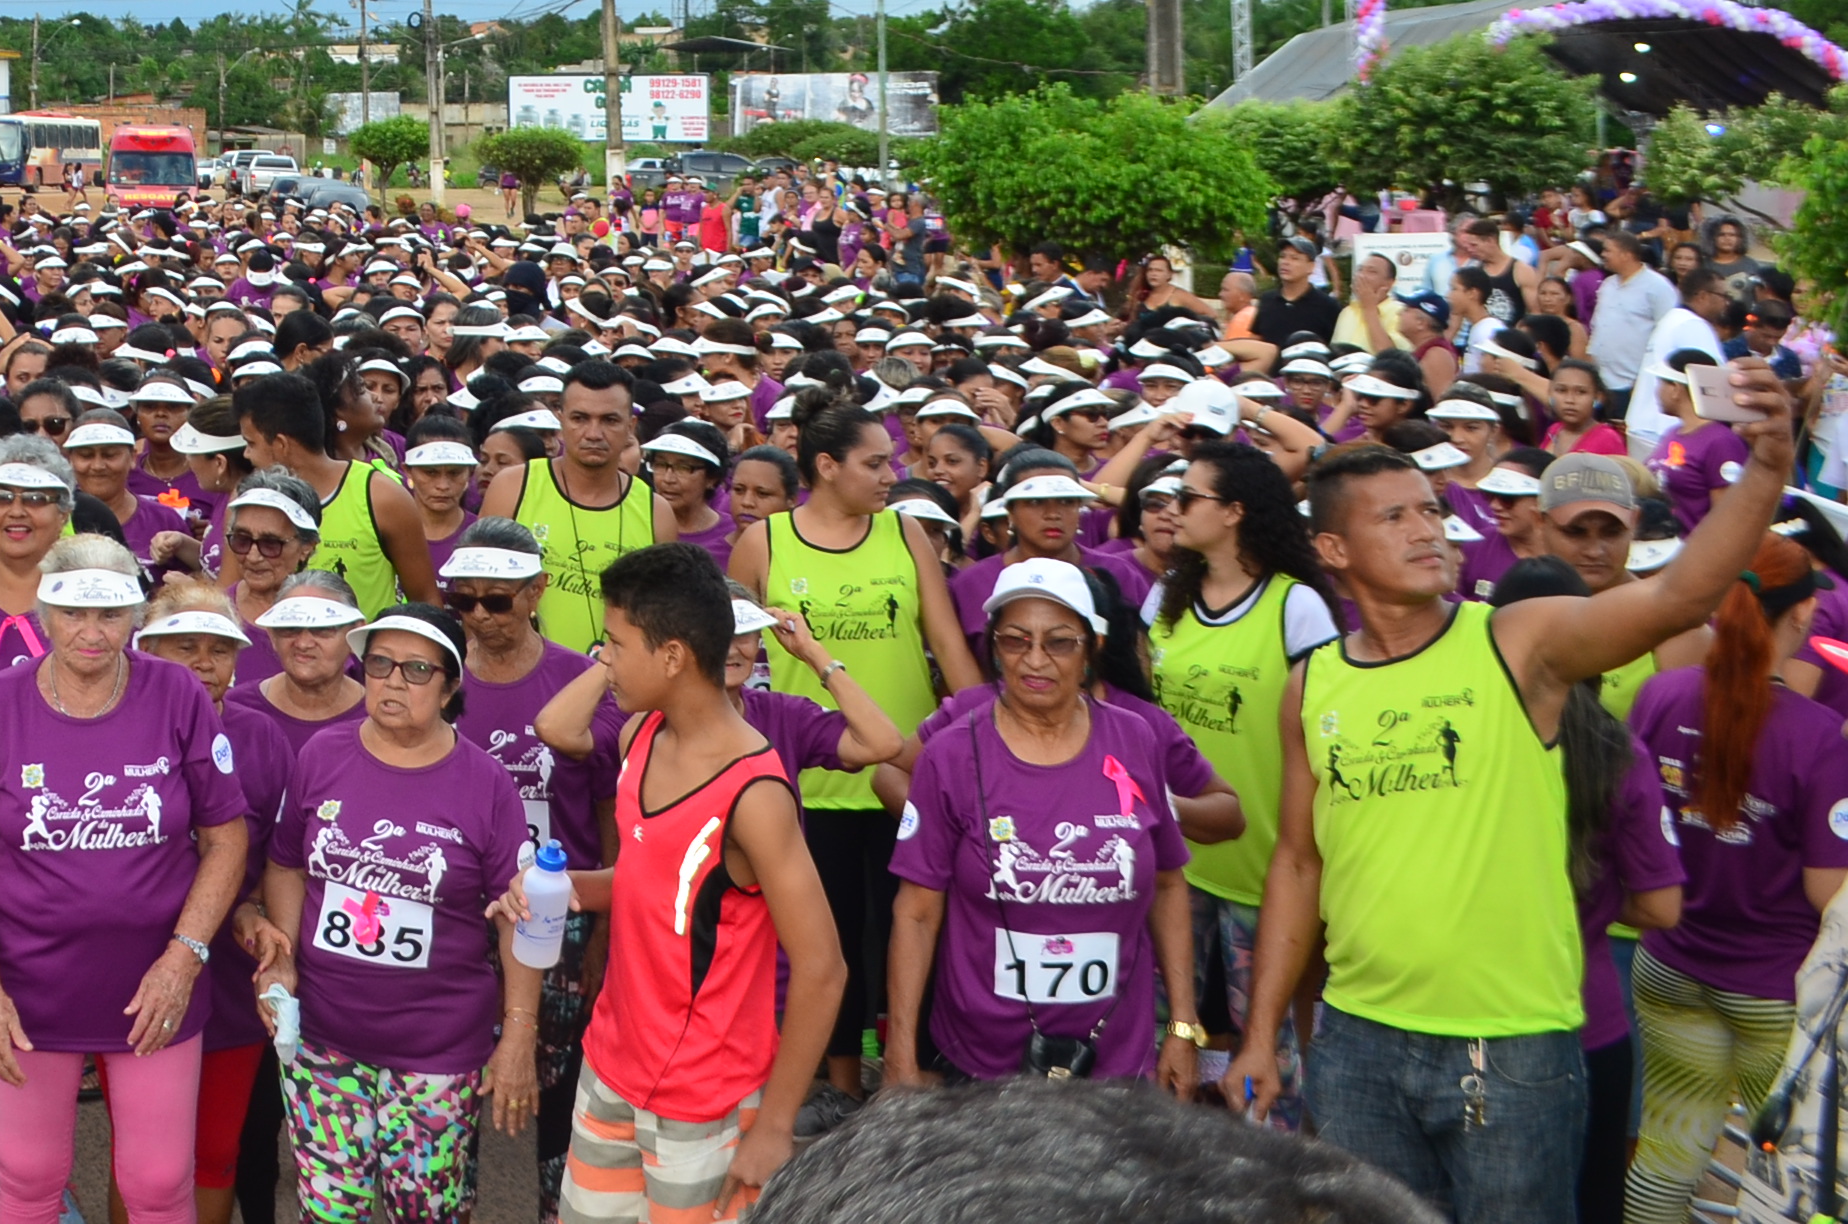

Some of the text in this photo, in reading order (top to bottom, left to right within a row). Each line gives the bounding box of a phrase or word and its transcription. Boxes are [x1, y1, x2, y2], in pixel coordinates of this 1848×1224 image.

[812, 619, 886, 641] Mulher
[124, 765, 159, 777] MULHER
[46, 806, 81, 821] Corrida
[91, 804, 145, 821] Caminhada
[50, 820, 146, 852] Mulher
[415, 822, 453, 841] MULHER
[325, 841, 361, 861] Corrida
[370, 852, 428, 874] Caminhada
[327, 860, 424, 901] Mulher
[1015, 873, 1120, 905] Mulher
[1005, 958, 1109, 998] 170
